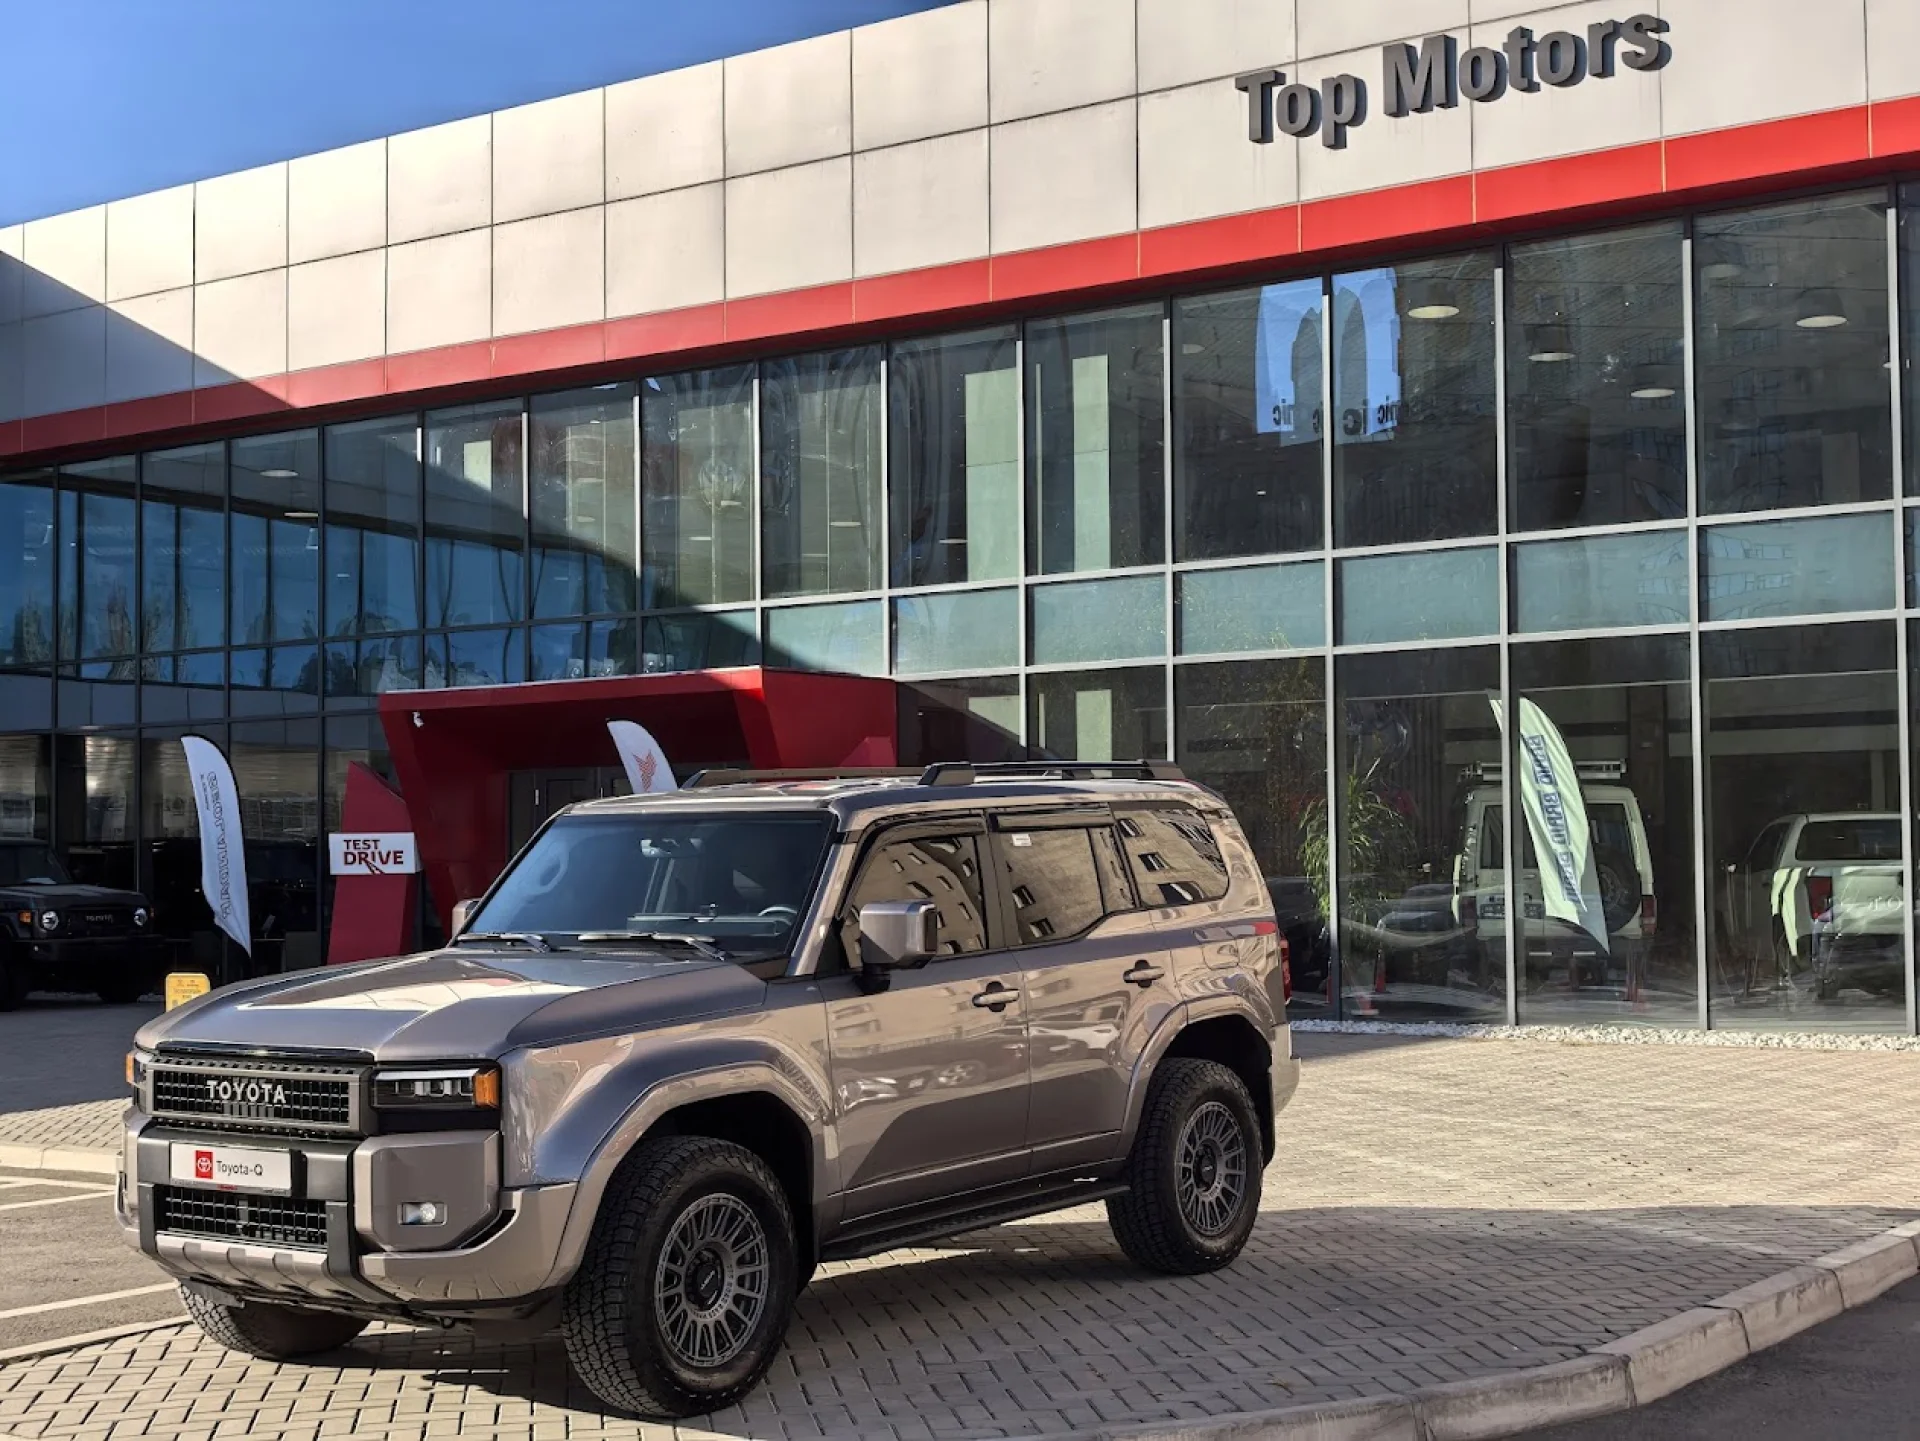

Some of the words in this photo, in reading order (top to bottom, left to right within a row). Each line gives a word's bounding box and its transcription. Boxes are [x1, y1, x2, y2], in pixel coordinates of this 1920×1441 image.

[1235, 69, 1368, 150] Top
[1382, 13, 1672, 118] Motors
[343, 839, 381, 850] TEST
[343, 850, 404, 869] DRIVE
[206, 1080, 287, 1104] TOYOTA
[216, 1160, 264, 1177] Toyota-Q
